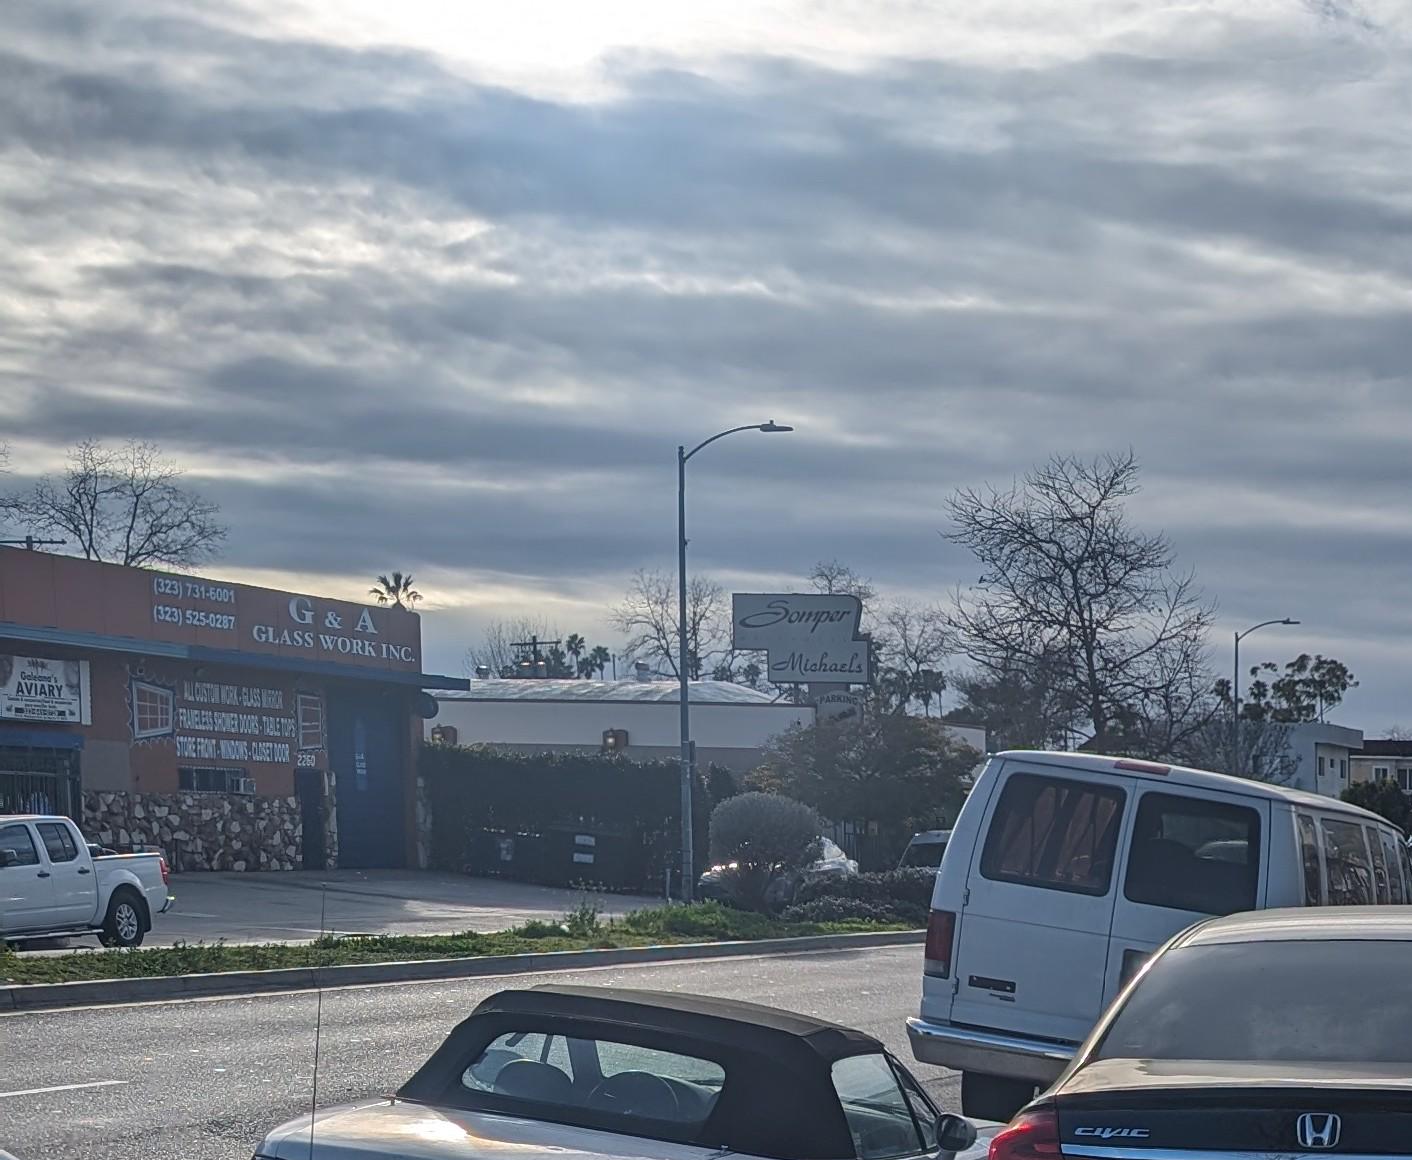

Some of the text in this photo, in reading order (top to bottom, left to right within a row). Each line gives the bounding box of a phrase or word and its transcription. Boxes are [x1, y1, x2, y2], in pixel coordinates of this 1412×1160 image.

[154, 577, 235, 603] (323) 731-6001
[154, 605, 235, 629] (323) 525-0287
[289, 597, 378, 634] G & A
[739, 599, 851, 633] Somper
[252, 625, 416, 662] GLASS WORK INC.
[771, 652, 863, 676] Michaels
[16, 681, 63, 697] AVIARY
[195, 682, 220, 704] CUSTOM
[220, 685, 240, 706] WORK
[242, 687, 260, 707] GLASS
[179, 708, 214, 731] FRAMELESS
[214, 711, 239, 733] SHOWER
[239, 714, 259, 735] DOORS
[262, 716, 280, 737] TABLE
[176, 735, 196, 758] STORE
[196, 737, 217, 760] FRONT
[220, 739, 248, 761] WINDOWS
[251, 741, 273, 763] CLOSET
[273, 743, 290, 763] DOOR
[1074, 1127, 1150, 1139] CIVIC
